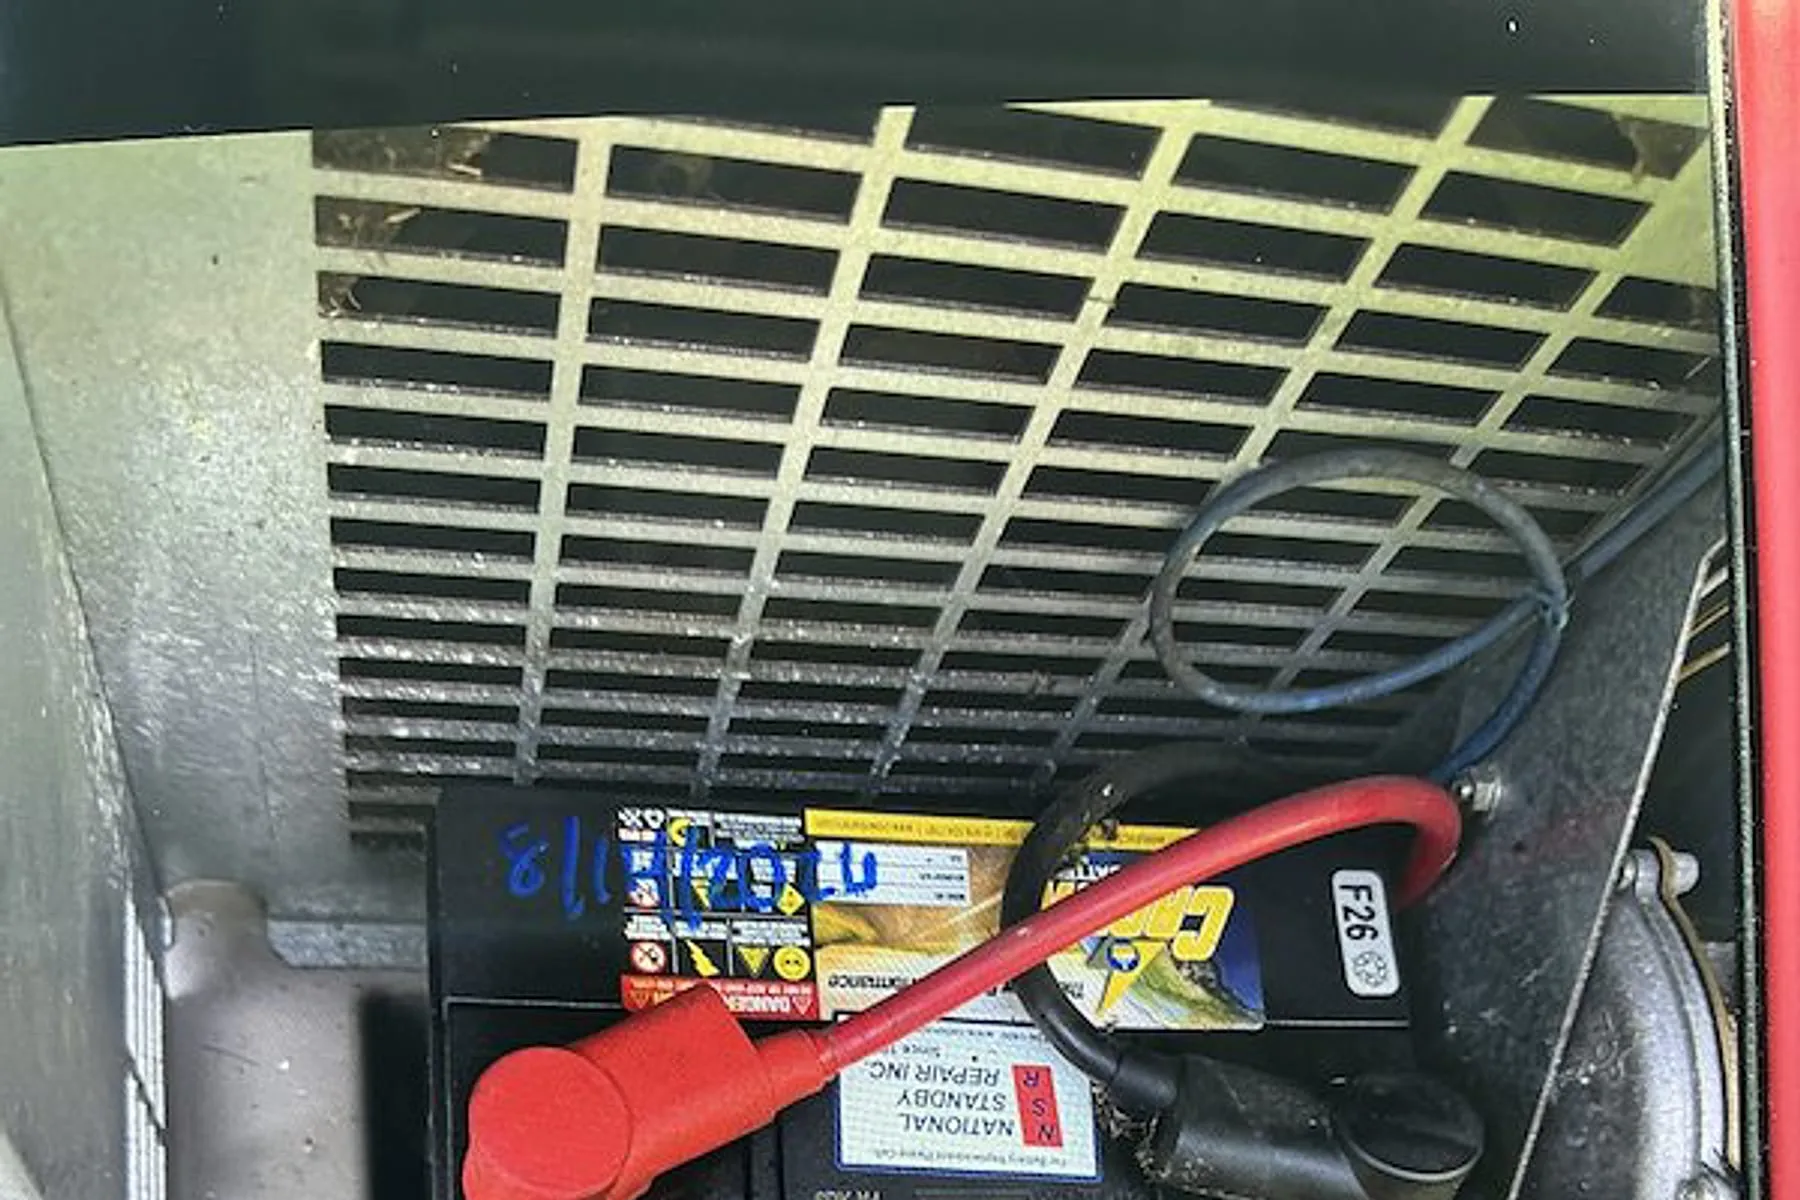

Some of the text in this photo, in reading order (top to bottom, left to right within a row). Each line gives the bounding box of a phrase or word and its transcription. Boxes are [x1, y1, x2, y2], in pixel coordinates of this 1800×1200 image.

[1339, 884, 1365, 942] F26
[864, 1061, 1000, 1087] REPAIR INC.
[896, 1088, 1007, 1109] STANDBY
[1023, 1070, 1055, 1141] N S R
[896, 1112, 1015, 1136] NATIONAL
